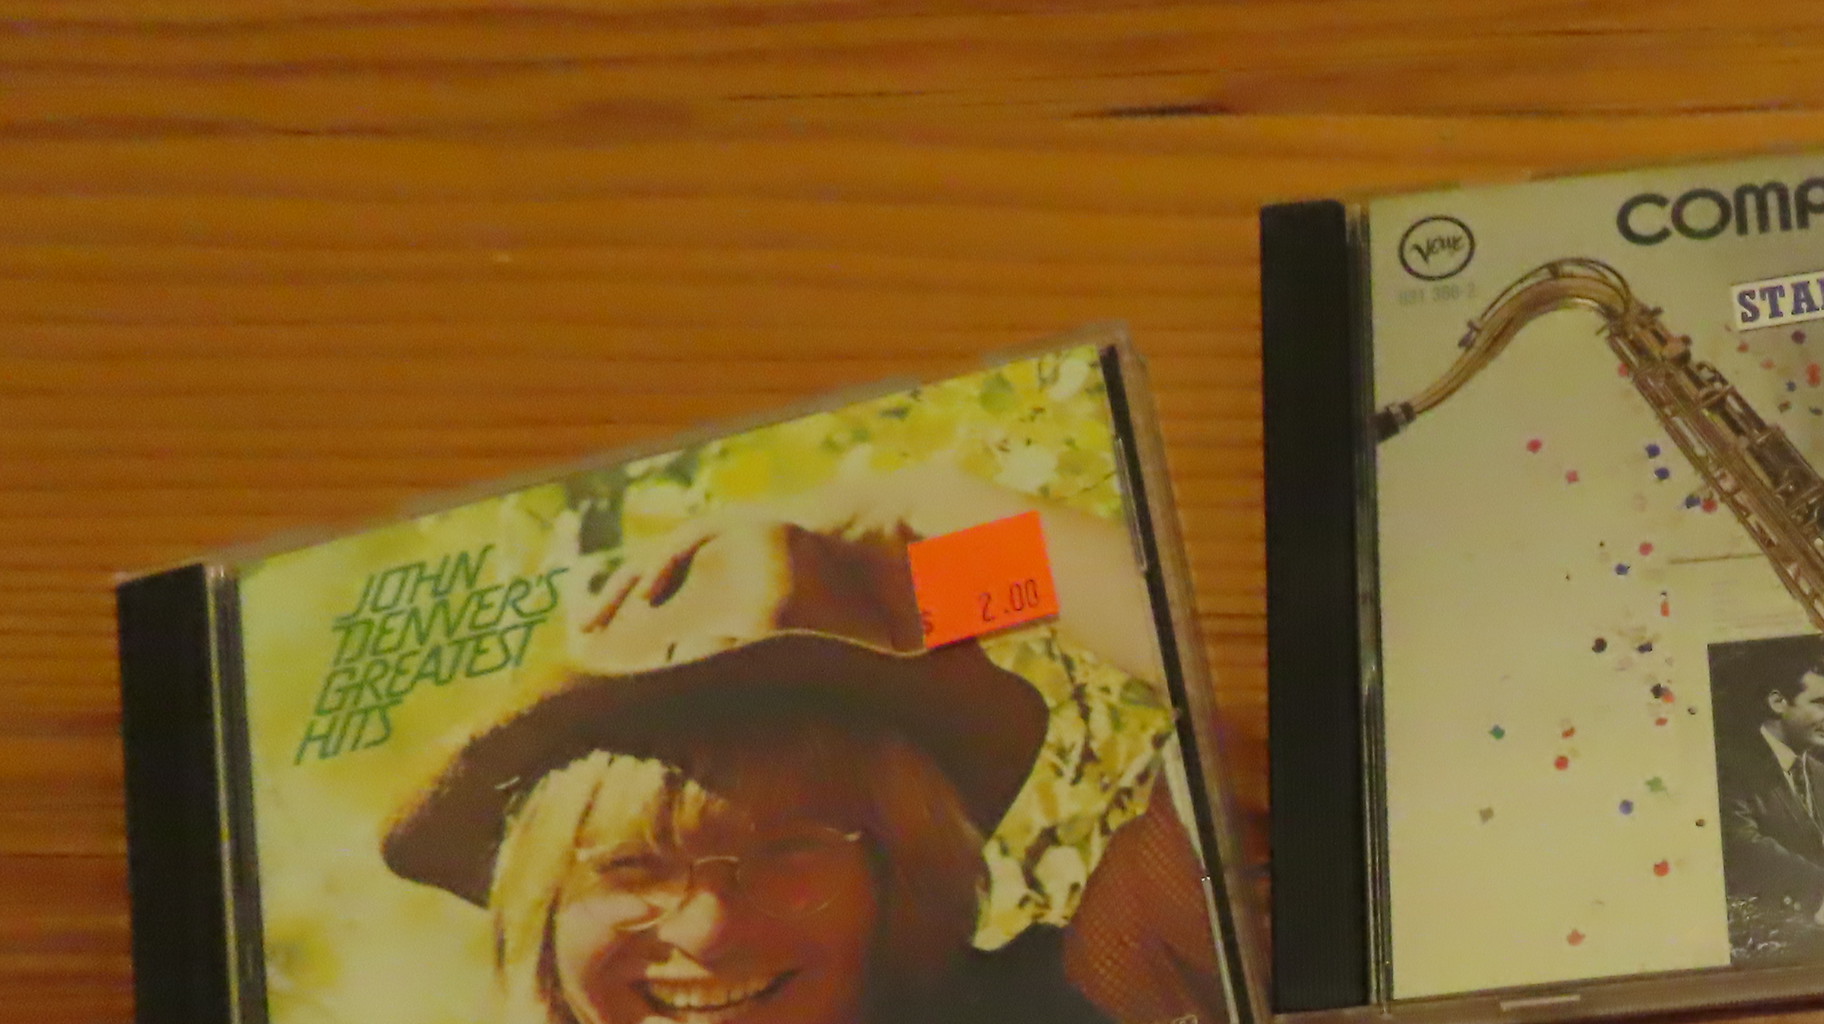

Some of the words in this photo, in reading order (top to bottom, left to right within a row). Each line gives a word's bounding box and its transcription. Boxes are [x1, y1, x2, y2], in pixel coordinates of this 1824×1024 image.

[334, 544, 495, 622] JOHN
[334, 568, 568, 667] DENVER'S
[315, 616, 547, 716] GREATEST
[293, 699, 405, 765] HITS
